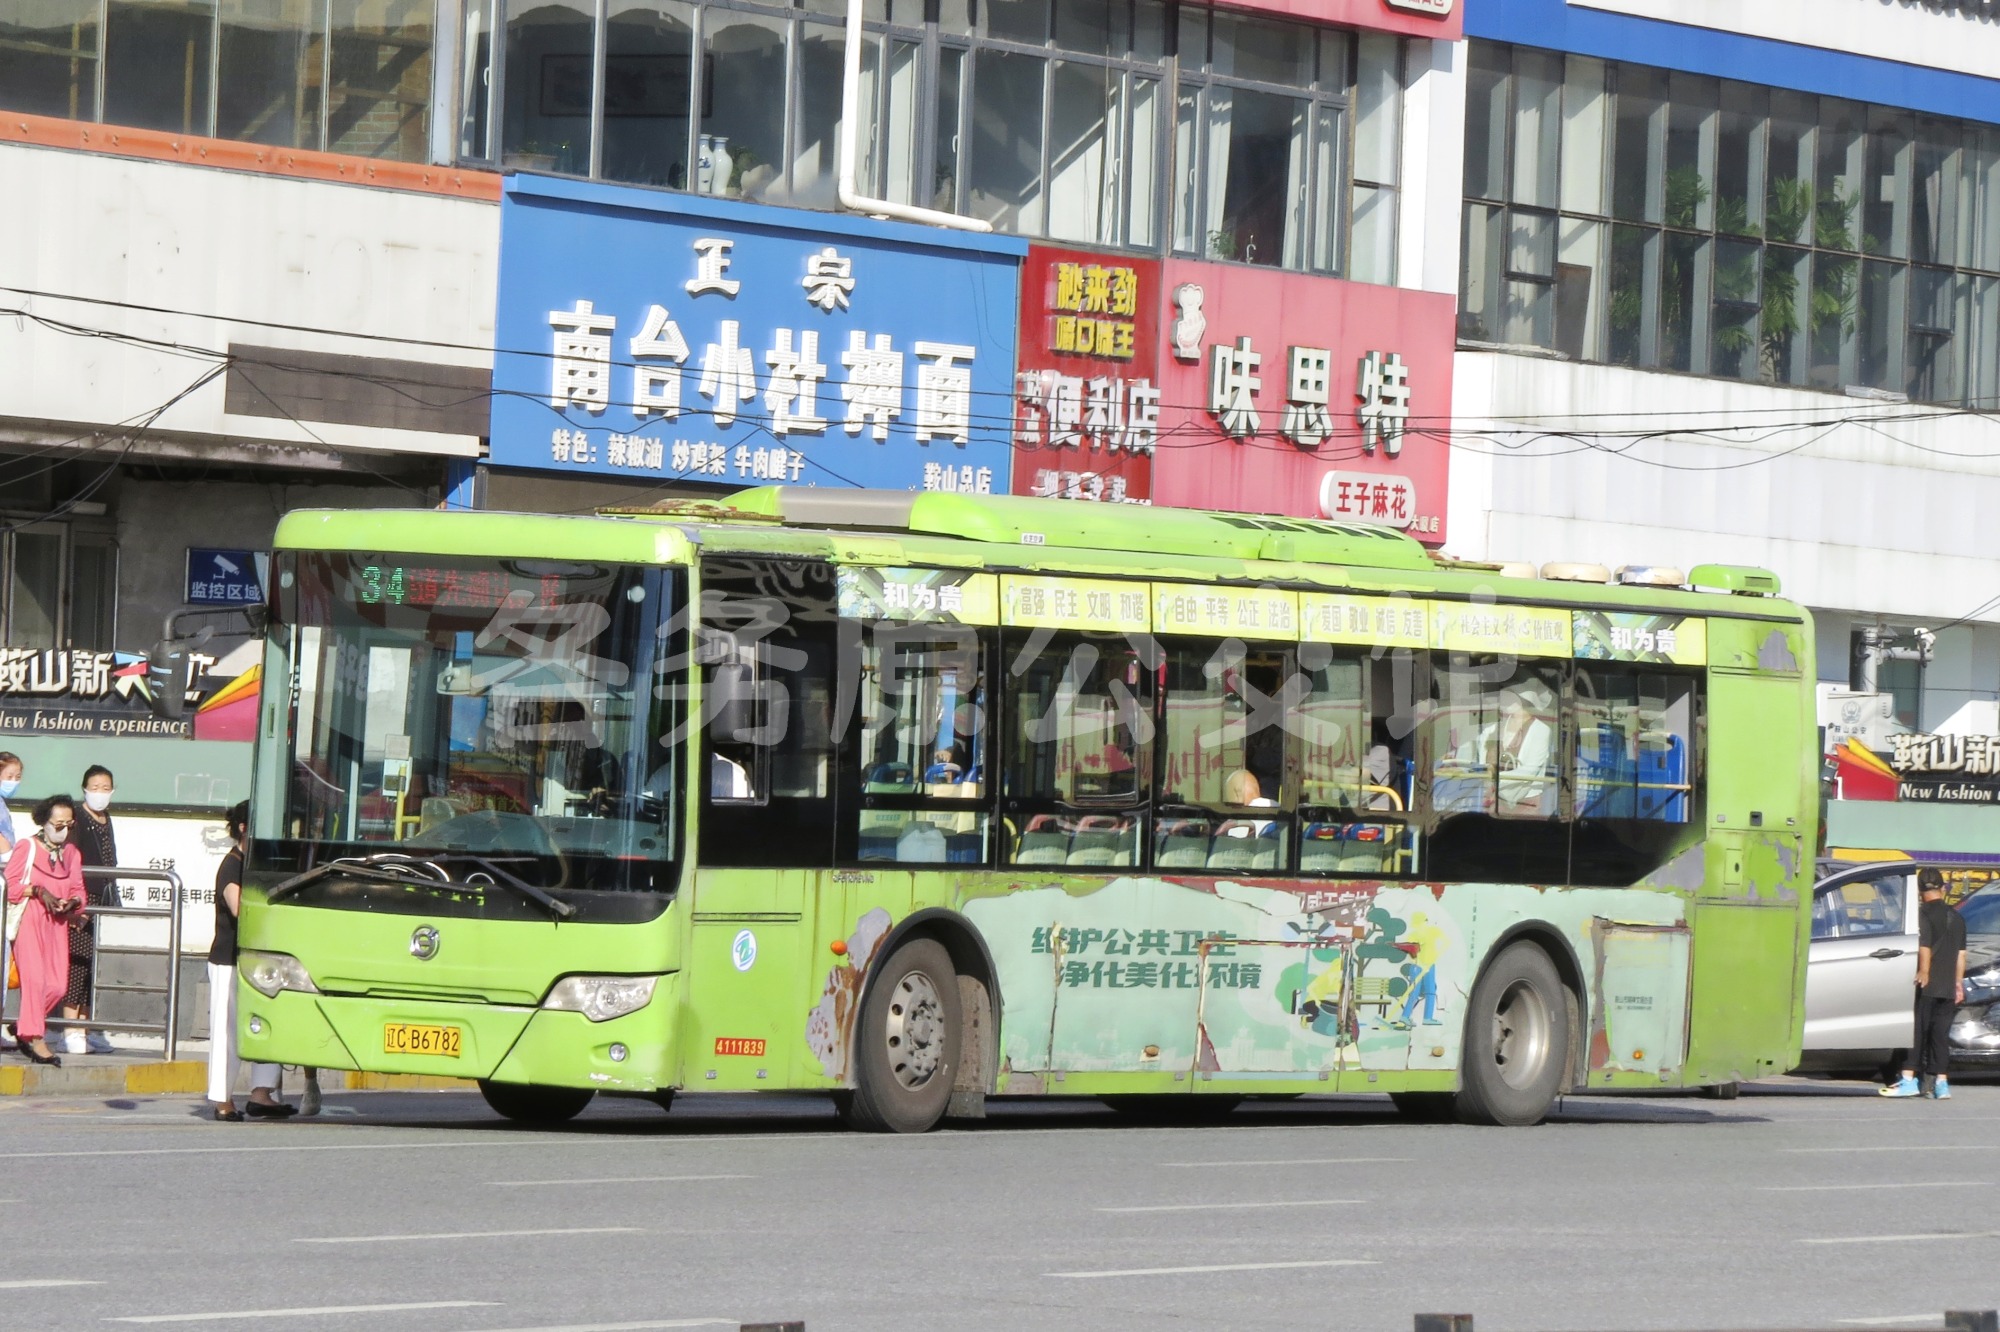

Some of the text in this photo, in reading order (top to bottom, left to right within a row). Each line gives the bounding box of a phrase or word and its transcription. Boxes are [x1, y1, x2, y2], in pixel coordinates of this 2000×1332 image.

[685, 237, 856, 311] 正宗
[1208, 336, 1411, 456] 味思特
[607, 433, 664, 470] 辣椒油
[672, 439, 727, 475] 炒鸡架
[924, 461, 992, 495] 鞍山总店
[1336, 481, 1407, 519] 王子麻花
[190, 581, 262, 601] 监控区域
[361, 565, 405, 605] 34
[882, 581, 963, 612] 和为贵
[1020, 586, 1144, 621] 富强 民主 文明 和谐
[1174, 595, 1290, 629] 自由 平等 公正 法治
[1321, 604, 1423, 637] 爱国 敬业 诚信 友善
[1610, 626, 1677, 653] 和为贵
[149, 857, 176, 872] 台球
[1031, 926, 1237, 956] 维护公共卫生
[1060, 960, 1262, 989] 净化美化环境
[716, 1039, 764, 1055] 4111839
